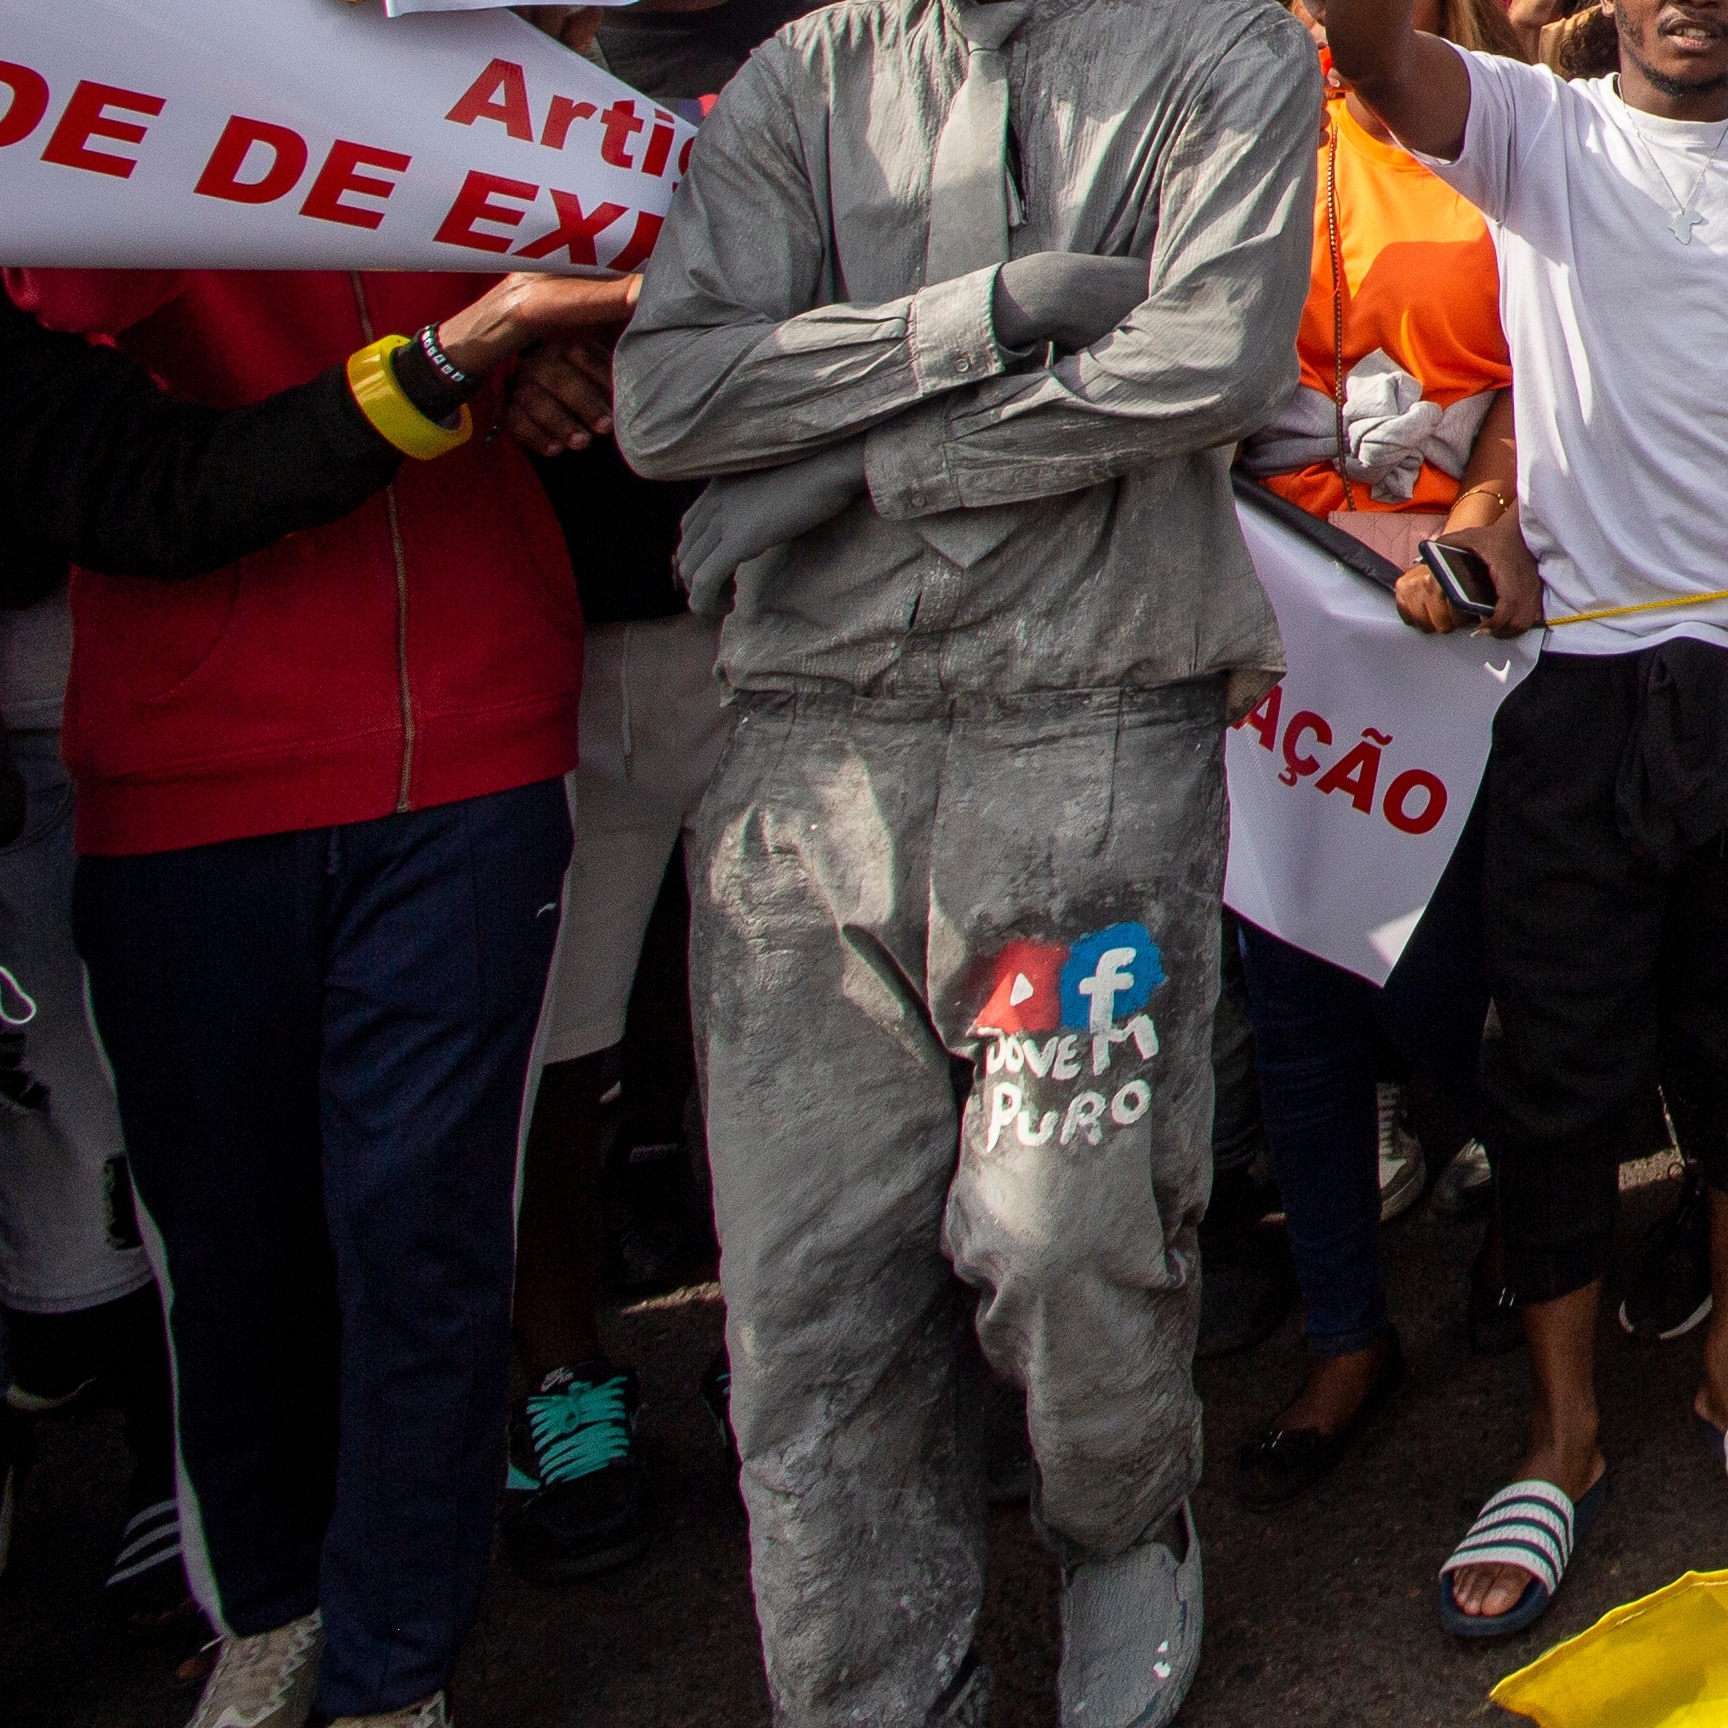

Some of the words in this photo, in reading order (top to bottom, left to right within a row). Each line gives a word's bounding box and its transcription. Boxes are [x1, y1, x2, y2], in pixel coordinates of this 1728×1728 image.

[193, 114, 413, 230] DE
[444, 57, 699, 186] Arti
[1232, 683, 1449, 836] AÇÃO
[985, 1078, 1152, 1154] PURO
